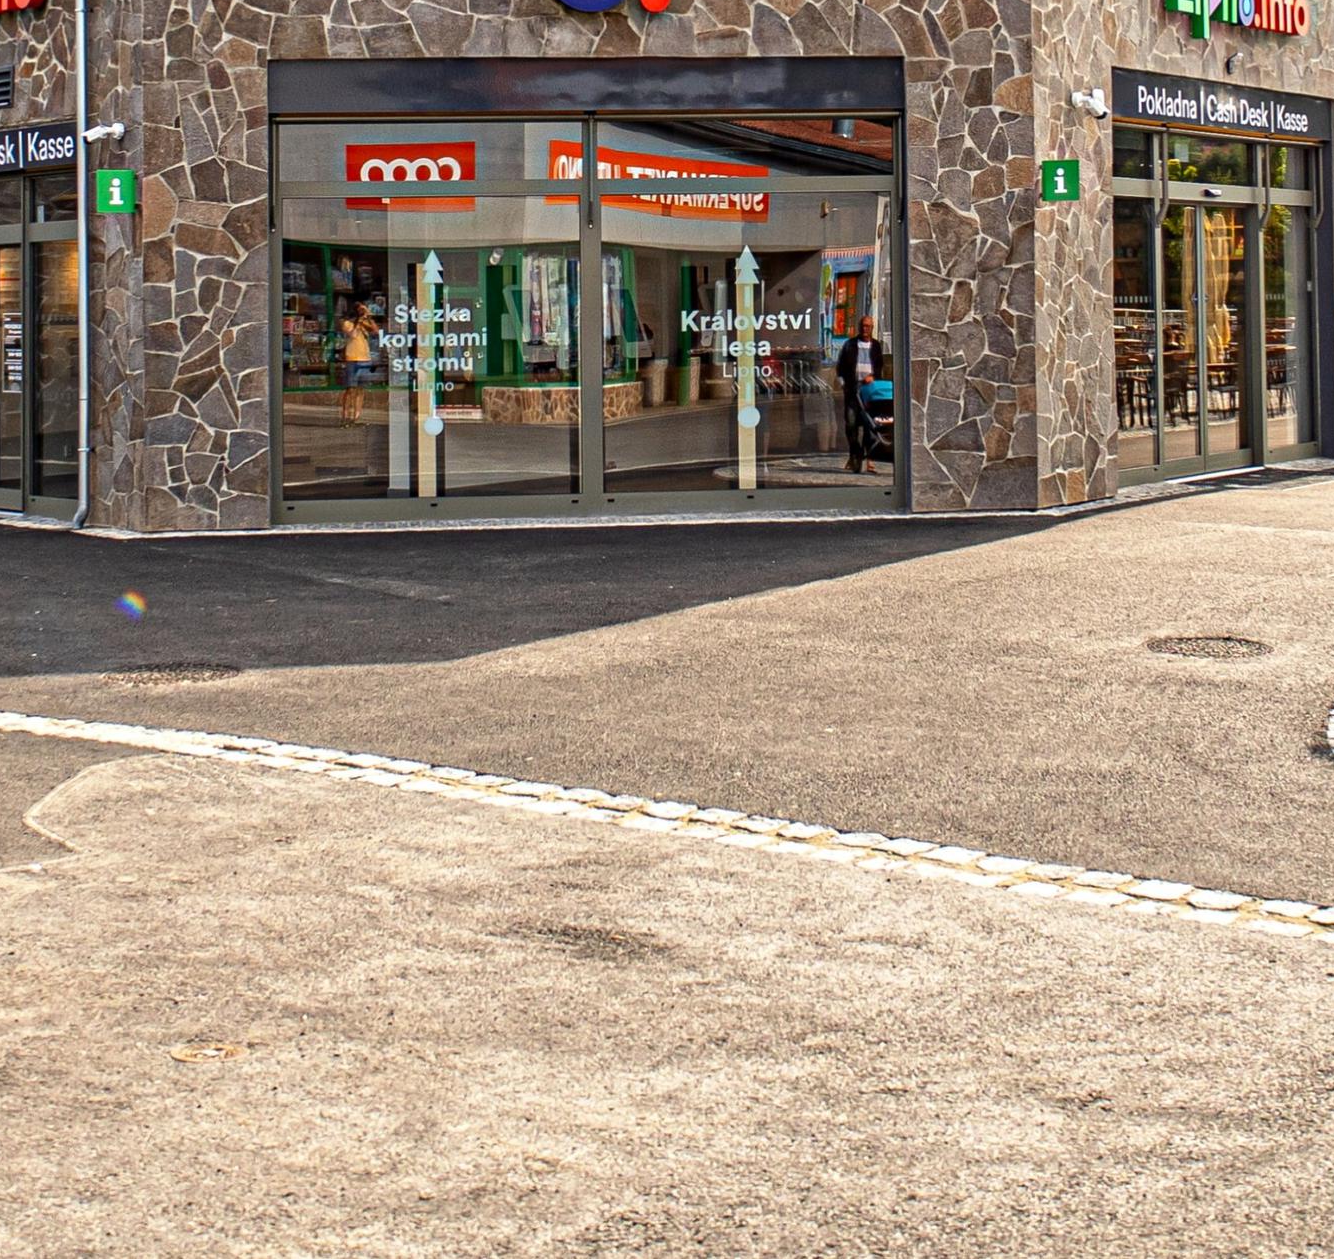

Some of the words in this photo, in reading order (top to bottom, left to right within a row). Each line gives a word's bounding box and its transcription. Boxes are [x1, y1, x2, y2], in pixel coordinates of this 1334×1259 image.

[1138, 85, 1197, 120] Pokladna
[1207, 94, 1237, 124] Cash
[1240, 99, 1269, 128] Desk
[1276, 105, 1309, 133] Kasse
[27, 131, 74, 161] Kasse
[394, 303, 471, 323] Stezka
[680, 308, 814, 333] Království
[378, 327, 488, 348] korunami
[722, 335, 772, 357] lesa
[392, 350, 474, 373] stromů
